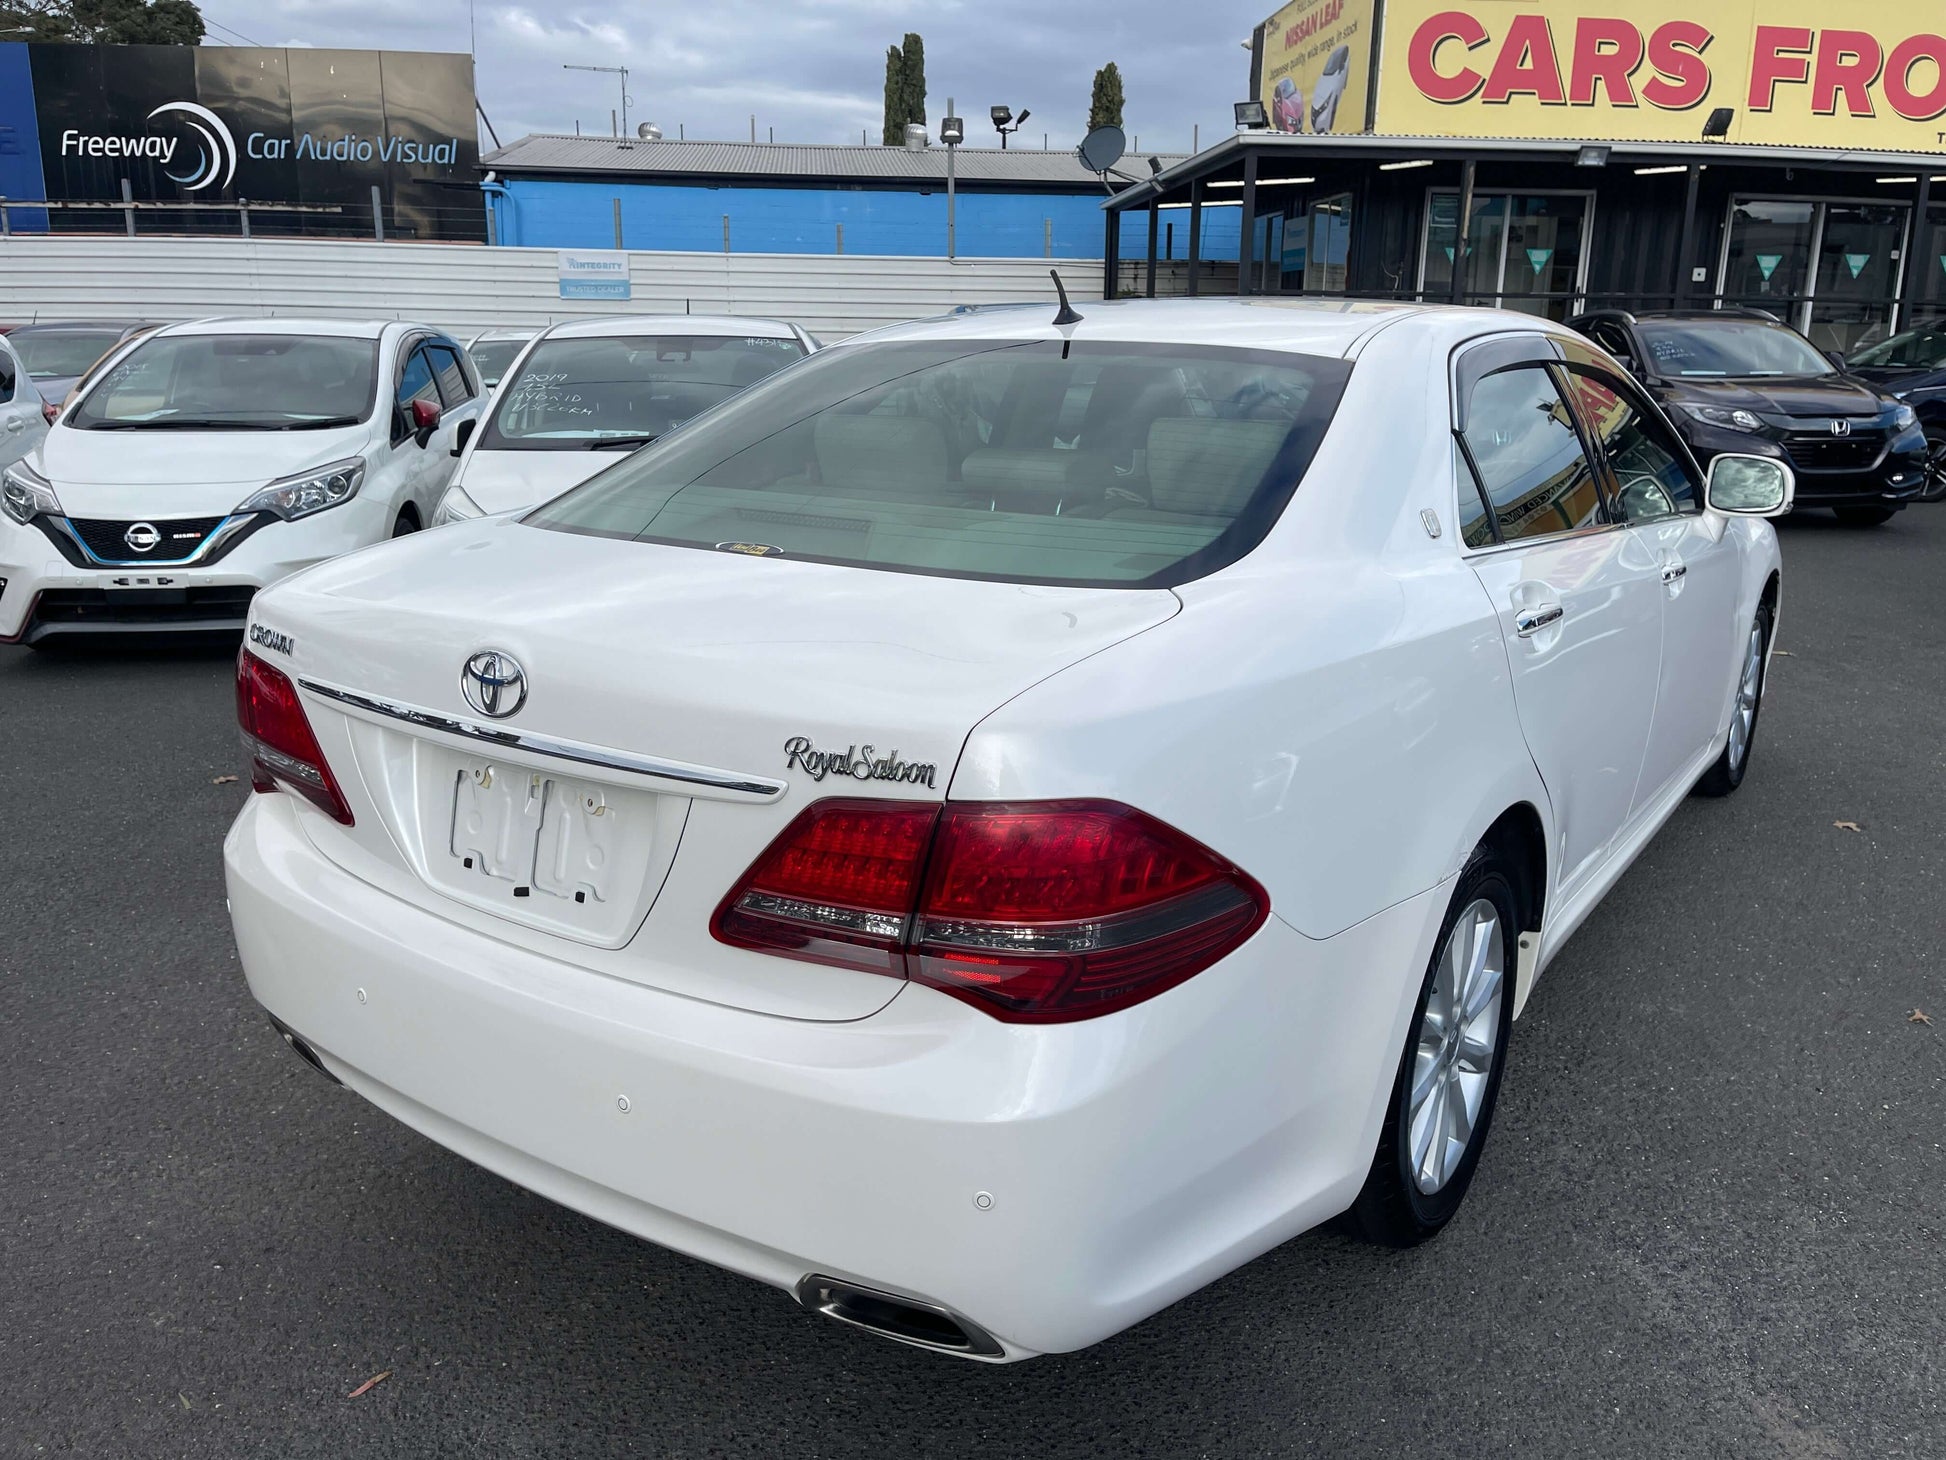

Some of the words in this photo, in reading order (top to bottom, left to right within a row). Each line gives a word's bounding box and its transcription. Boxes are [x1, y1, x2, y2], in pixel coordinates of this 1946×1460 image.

[1284, 10, 1318, 51] NISSAN
[1319, 0, 1344, 31] LEAF
[1407, 11, 1714, 111] CARS
[1747, 25, 1946, 122] FRO
[61, 130, 178, 163] Freeway
[247, 132, 291, 159] Car
[296, 133, 373, 162] Audio
[377, 136, 458, 165] Visual
[523, 373, 568, 383] 2019
[250, 623, 295, 657] CROWN
[784, 735, 856, 782] Royal
[852, 744, 938, 789] Saloon
